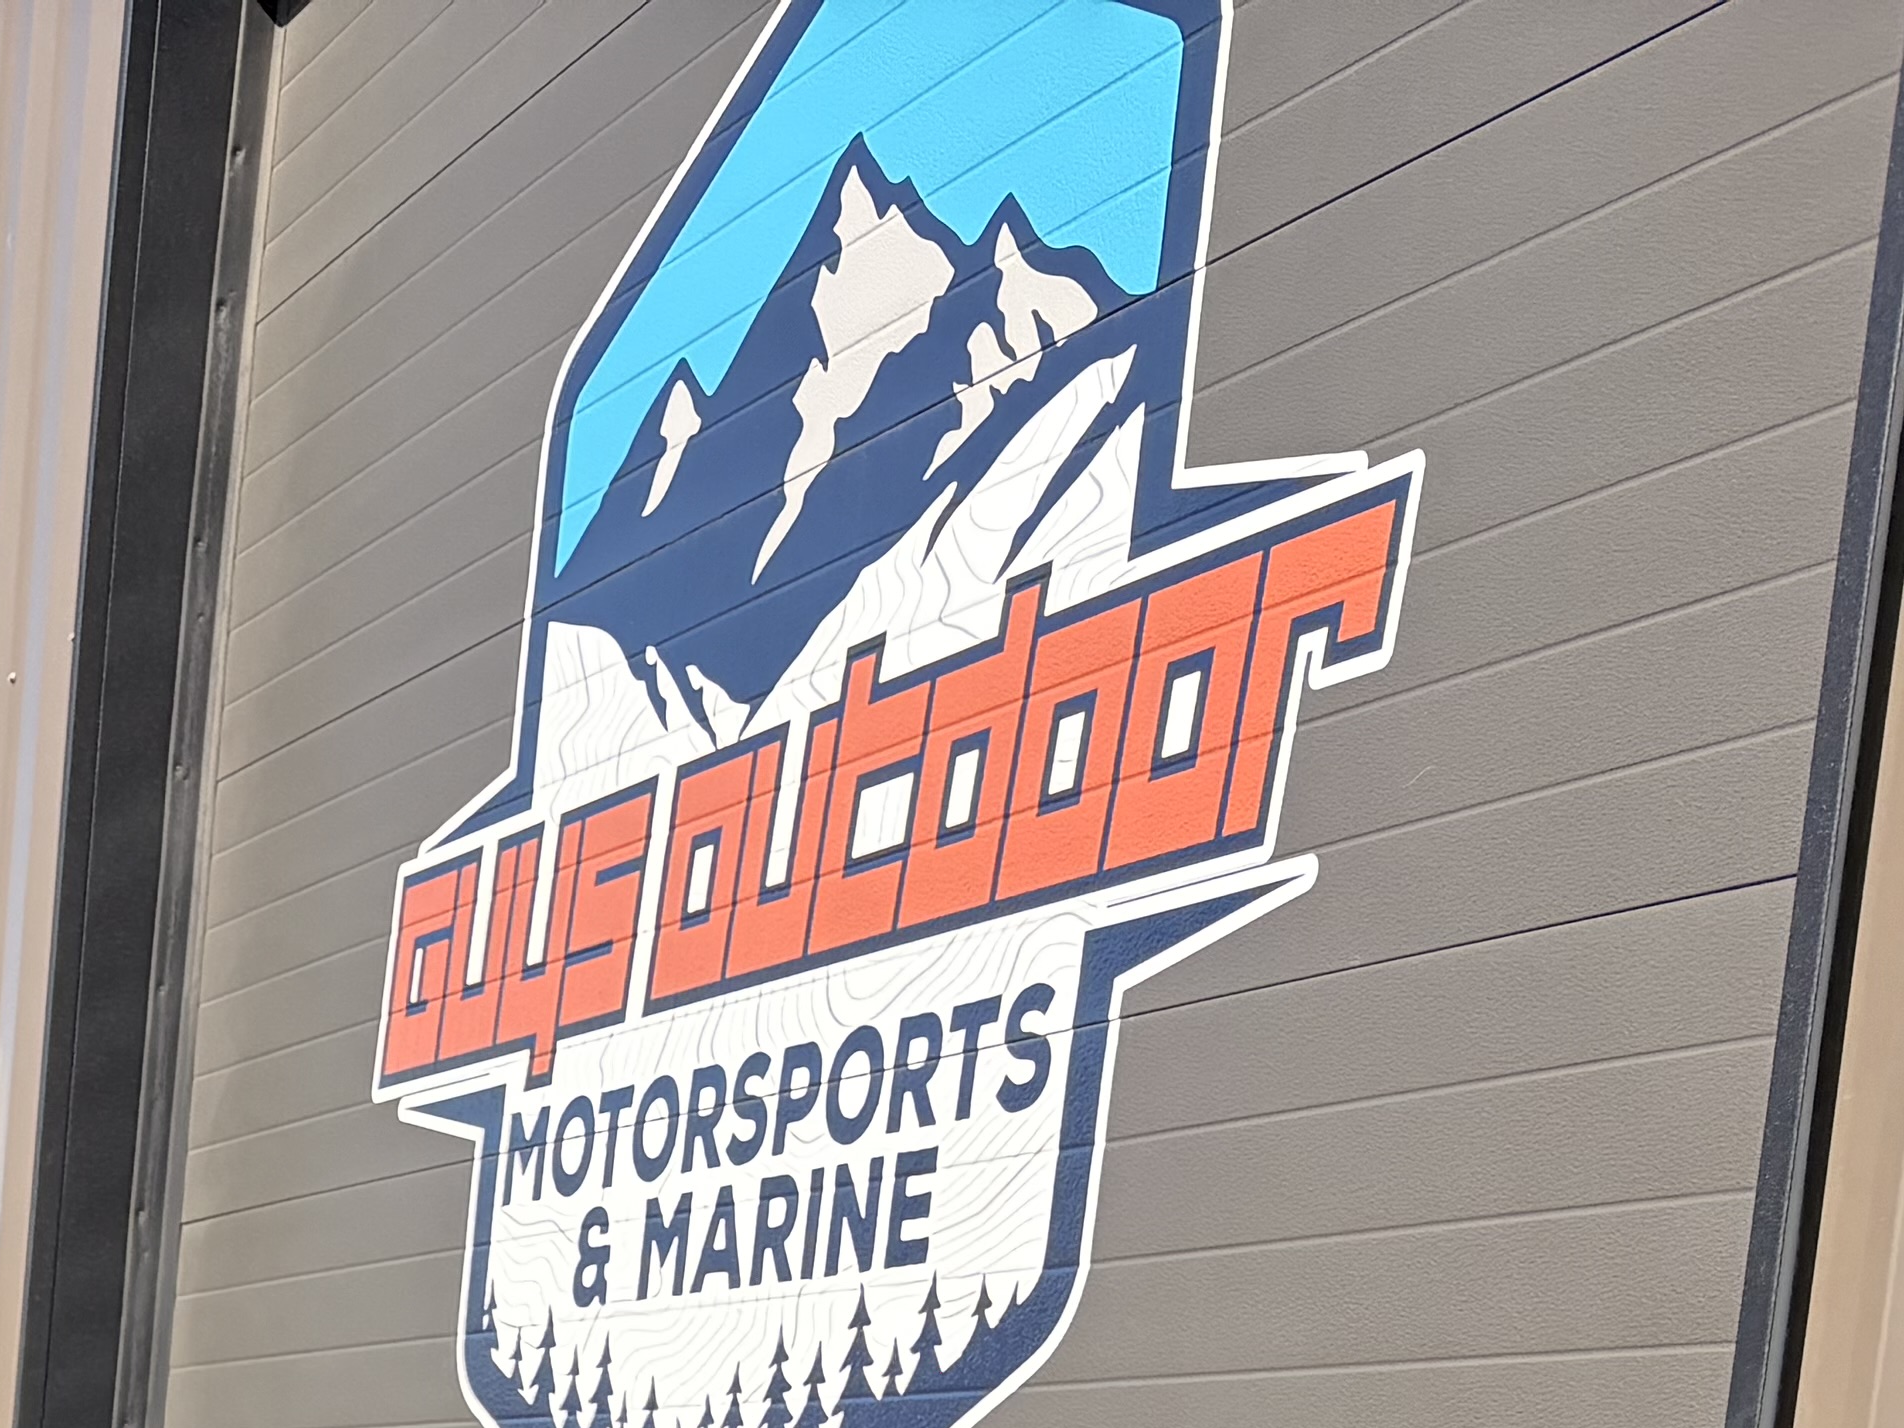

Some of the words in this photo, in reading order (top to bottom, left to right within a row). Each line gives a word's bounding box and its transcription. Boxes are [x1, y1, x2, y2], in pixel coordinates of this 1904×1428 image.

[505, 982, 1053, 1206] MOTORSPORTS
[572, 1206, 609, 1307] &
[637, 1147, 939, 1302] MARINE
